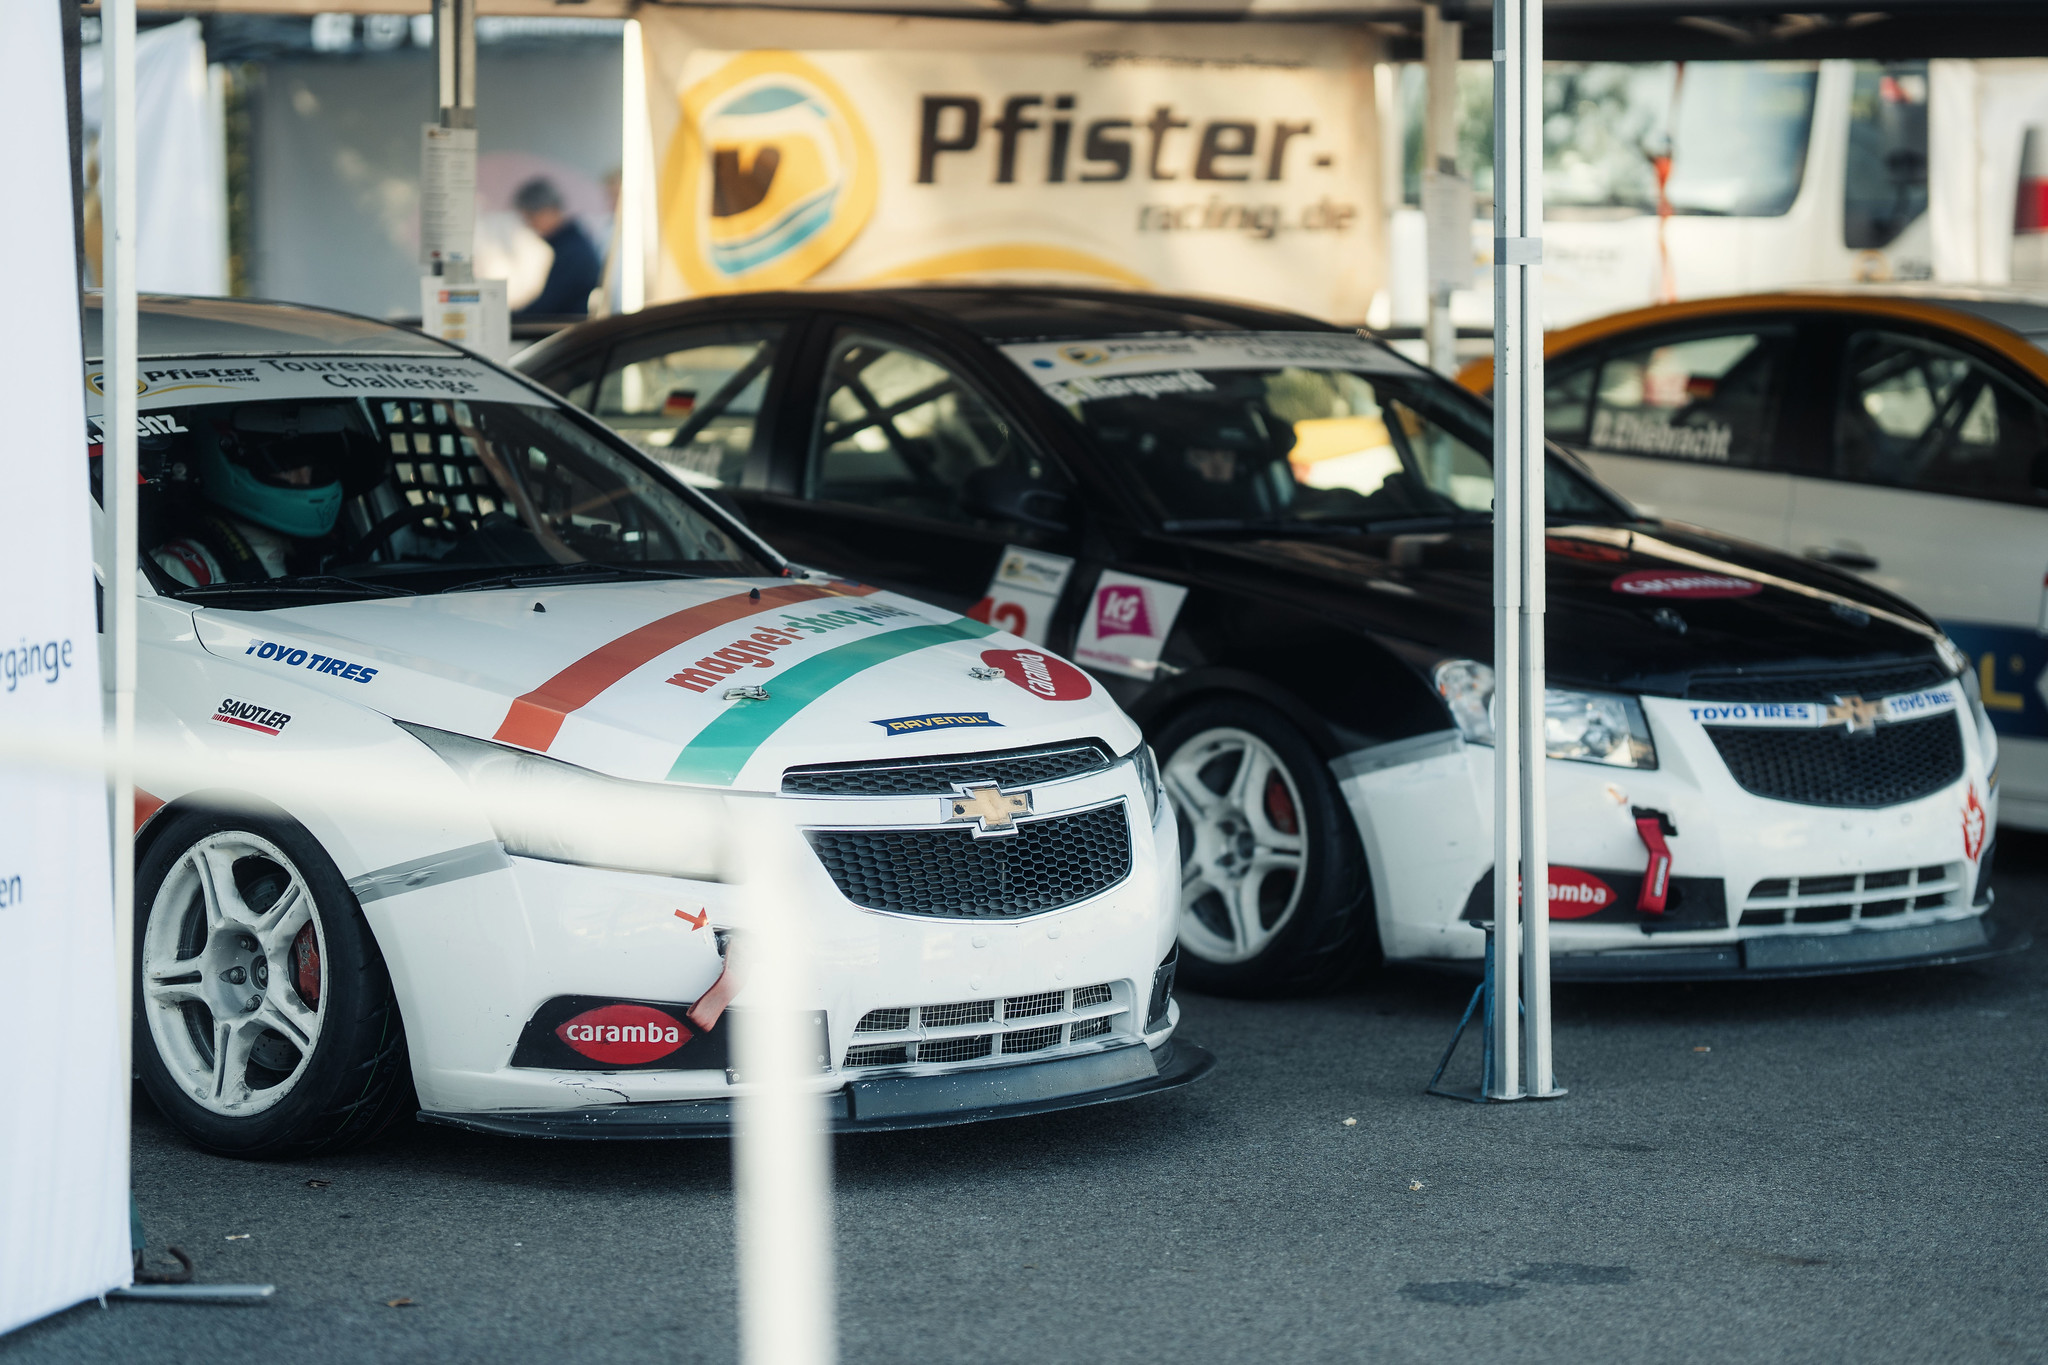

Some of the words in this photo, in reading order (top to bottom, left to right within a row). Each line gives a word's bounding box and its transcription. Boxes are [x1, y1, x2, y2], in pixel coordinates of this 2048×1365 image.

[914, 93, 1333, 184] Pfister-
[144, 366, 256, 382] Pfister
[321, 373, 480, 394] Challenge
[1621, 575, 1752, 594] caramba
[245, 638, 308, 666] TOYO
[306, 653, 379, 684] TIRES
[1012, 652, 1057, 697] caramba
[217, 698, 292, 730] SANDTLER
[1690, 707, 1747, 721] TOYO
[1751, 704, 1809, 719] TIRES
[1890, 694, 1925, 713] TOYO
[888, 715, 989, 731] RAVENOL
[566, 1022, 679, 1043] caramba
